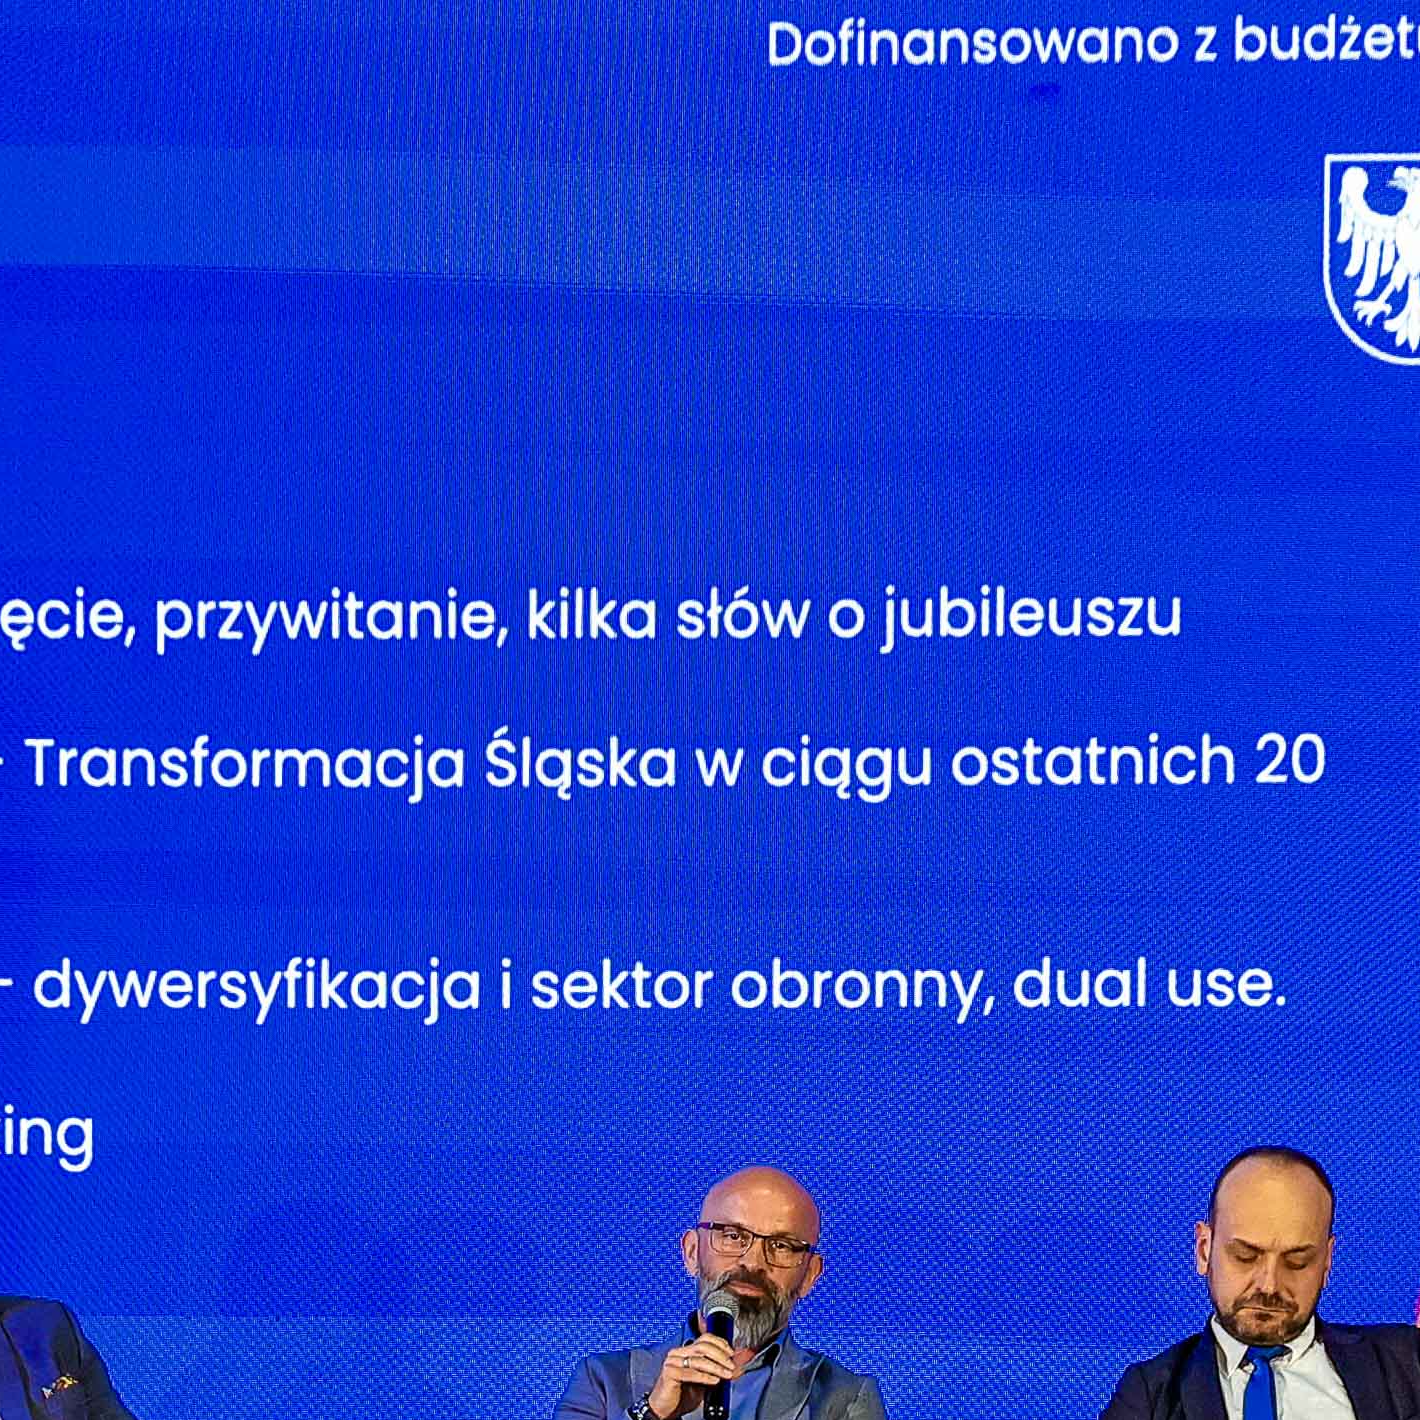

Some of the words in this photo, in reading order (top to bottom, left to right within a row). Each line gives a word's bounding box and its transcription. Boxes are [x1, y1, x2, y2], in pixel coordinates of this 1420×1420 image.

[767, 17, 1179, 67] Dofinansowano
[1195, 26, 1217, 62] z
[156, 586, 508, 656] przywitanie,
[528, 586, 656, 640] kilka
[677, 585, 811, 639] słów
[828, 598, 865, 638] o
[879, 584, 1181, 654] jubileuszu
[24, 734, 464, 804] Transformacja
[485, 725, 676, 801] Śląska
[695, 748, 744, 787] w
[762, 734, 931, 804] ciągu
[951, 732, 1235, 786] ostatnich
[1255, 732, 1325, 784] 20
[34, 956, 480, 1026] dywersyfikacja
[500, 958, 512, 1009] i
[532, 957, 714, 1009] sektor
[731, 956, 995, 1025] obronny,
[1013, 955, 1147, 1008] dual
[1168, 967, 1286, 1007] use.
